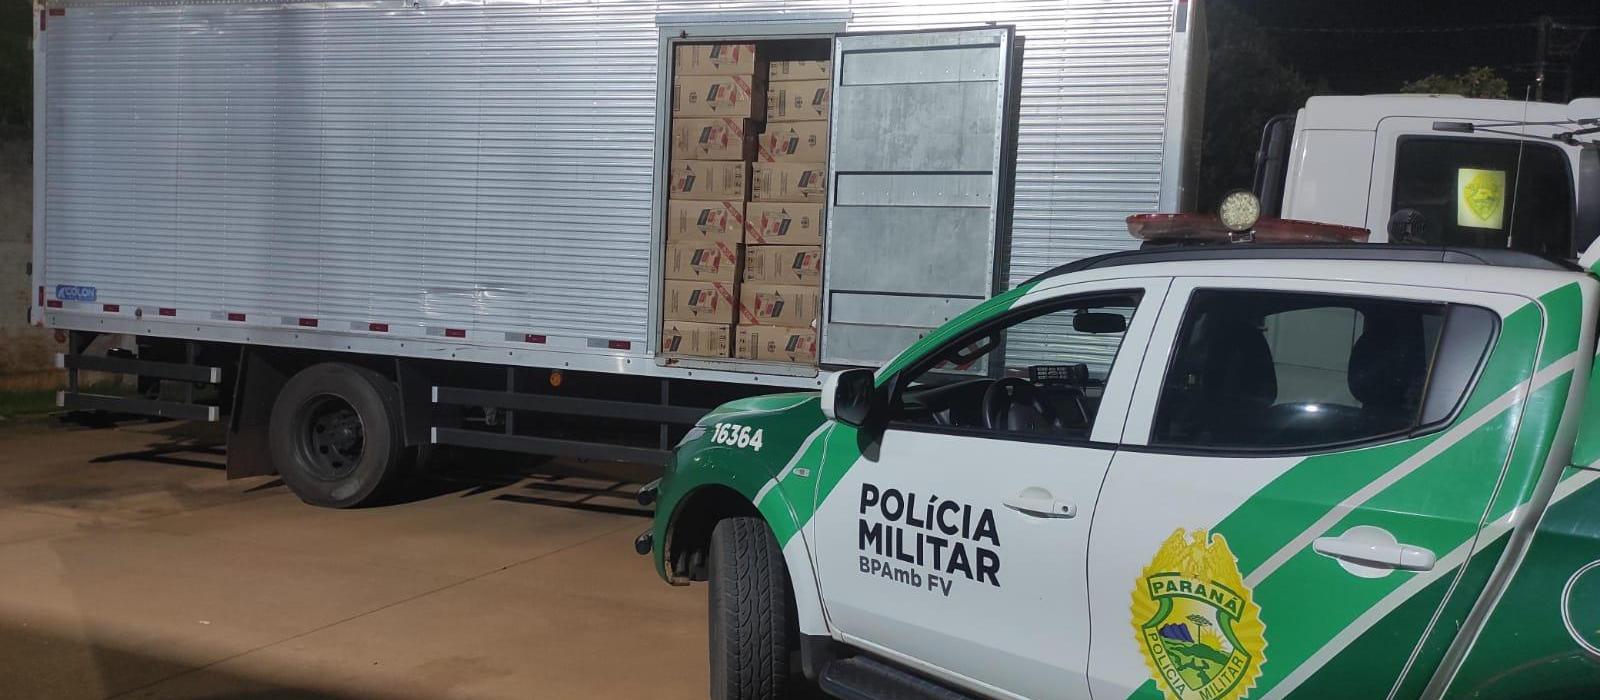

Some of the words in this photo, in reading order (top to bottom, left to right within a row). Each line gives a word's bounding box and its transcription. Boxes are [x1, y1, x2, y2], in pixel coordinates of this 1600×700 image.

[711, 422, 763, 452] 16364
[858, 519, 1000, 587] MILITAR
[859, 555, 922, 588] BPAmb
[927, 573, 953, 597] FV
[1152, 580, 1238, 613] PARANÁ
[1148, 633, 1185, 695] POLICIA
[1199, 656, 1244, 700] MILITAR
